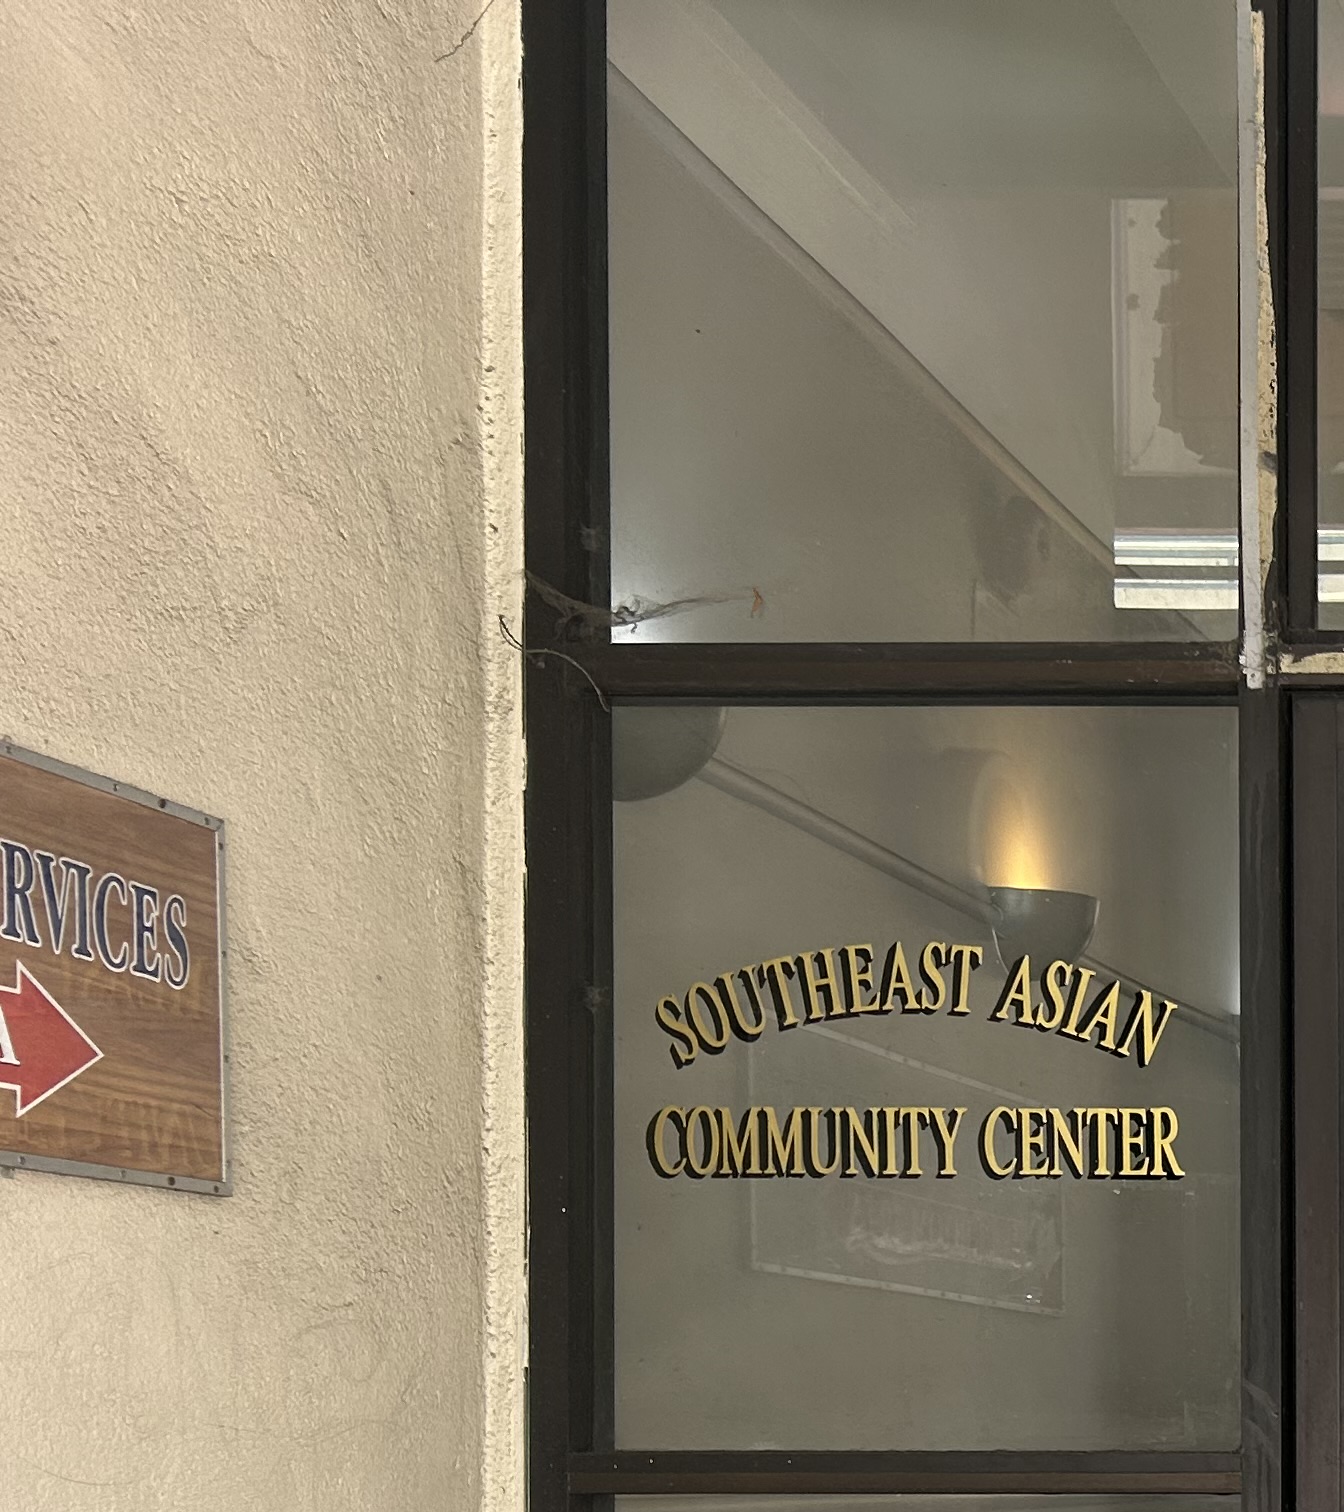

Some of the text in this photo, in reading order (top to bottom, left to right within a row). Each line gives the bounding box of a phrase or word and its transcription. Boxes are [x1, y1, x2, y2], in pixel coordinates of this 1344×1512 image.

[655, 941, 1178, 1069] SOUTHEAST ASIAN
[646, 1106, 1186, 1180] COMMUNITY CENTER
